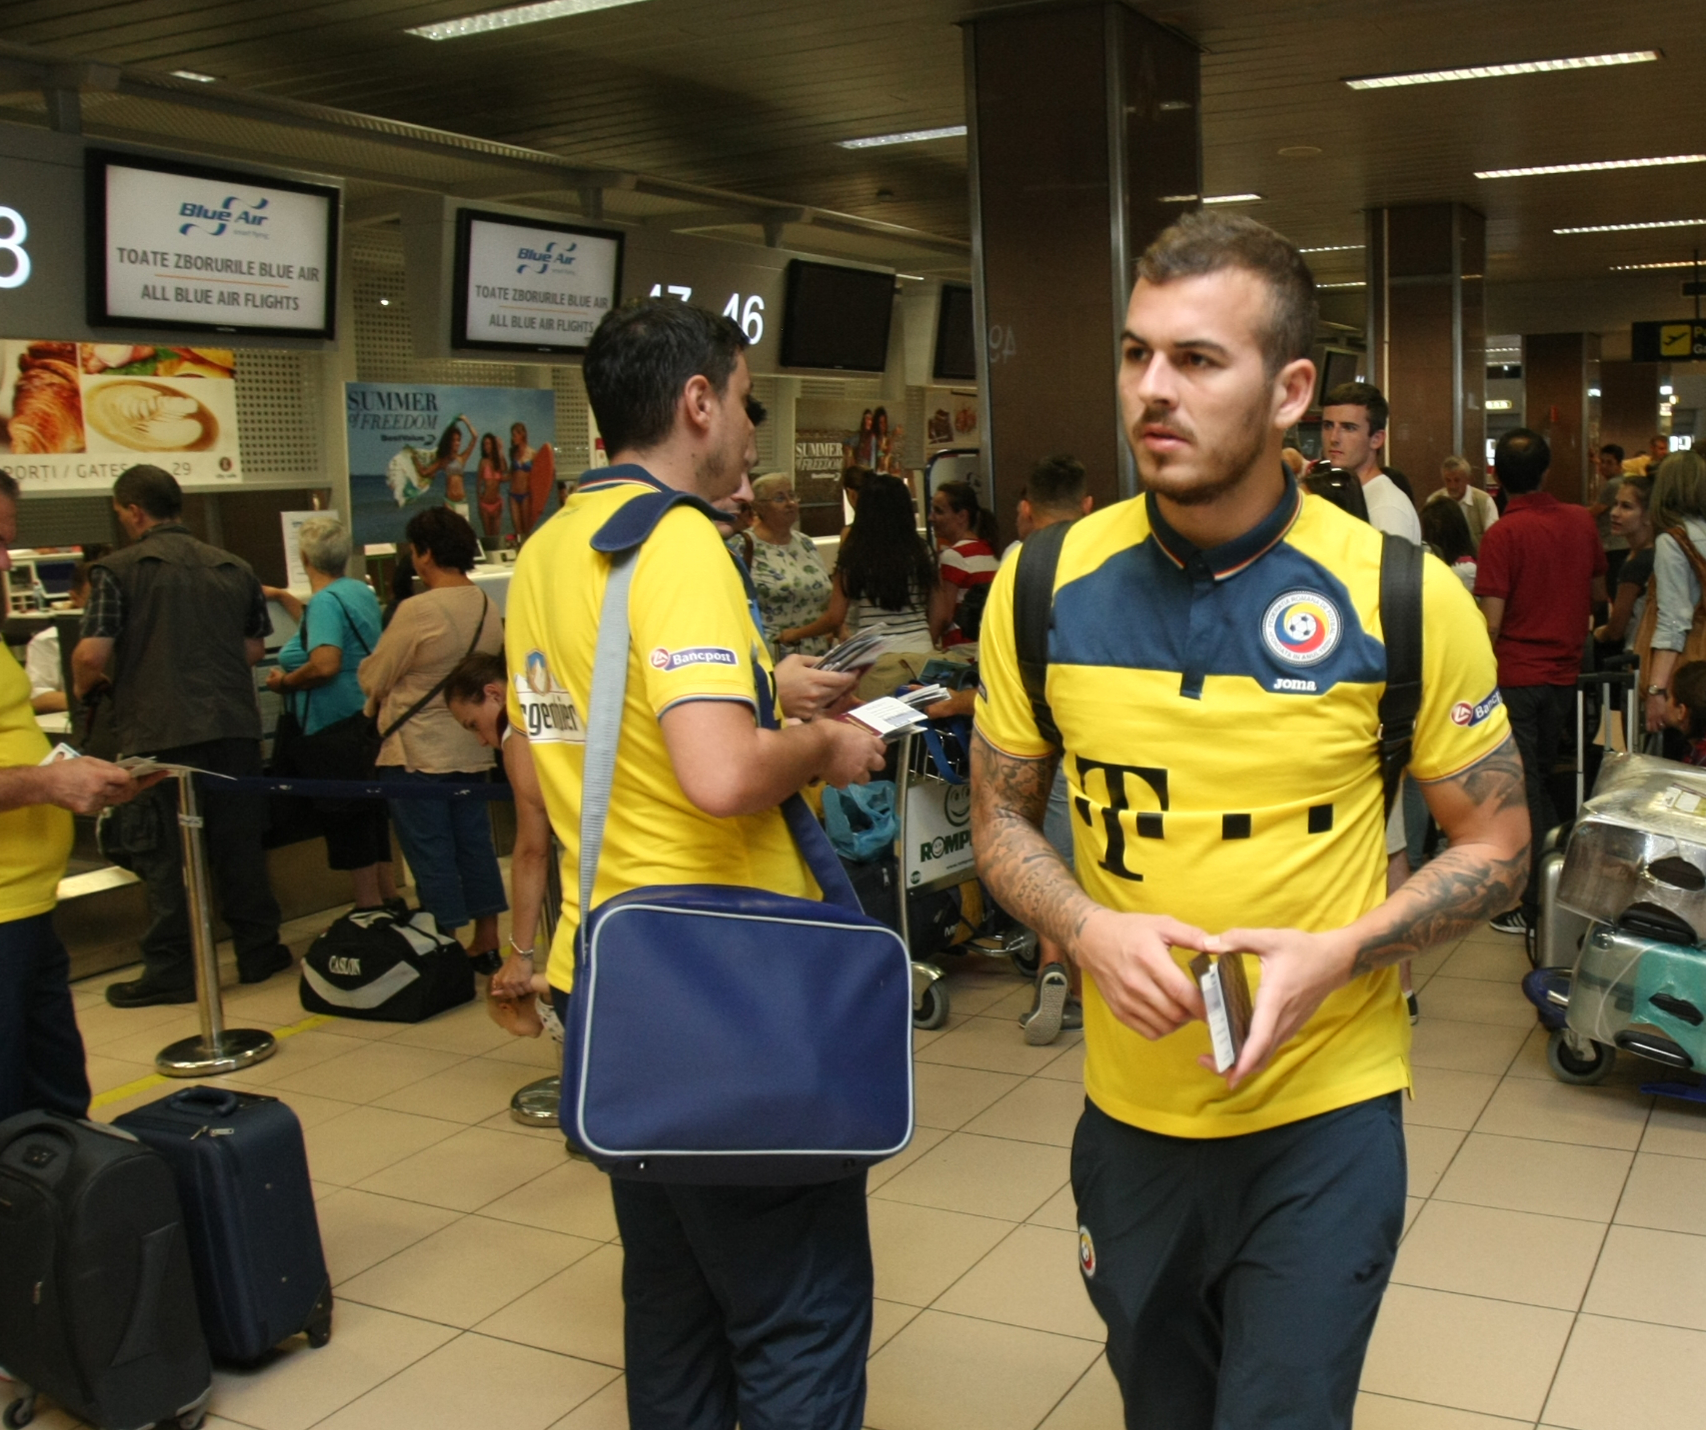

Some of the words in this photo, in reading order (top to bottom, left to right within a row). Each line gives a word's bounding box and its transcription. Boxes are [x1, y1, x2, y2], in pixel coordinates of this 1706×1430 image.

[179, 202, 232, 222] Blue
[234, 210, 268, 226] Air
[116, 247, 170, 268] TOATE
[174, 253, 255, 276] ZBORURILE
[258, 261, 294, 280] BLUE
[298, 265, 320, 282] AIR
[517, 248, 552, 262] Blue
[553, 253, 576, 265] Air
[141, 284, 170, 302] ALL
[174, 287, 212, 305] BLUE
[217, 289, 240, 307] AIR
[244, 293, 299, 311] FLIGHTS
[475, 285, 509, 301] TOATE
[512, 289, 565, 305] ZBORURILE
[568, 293, 590, 308] BLUE
[593, 296, 608, 309] AIR
[489, 314, 508, 328] ALL
[511, 315, 536, 330] BLUE
[539, 317, 555, 332] AIR
[557, 319, 594, 334] FLIGHTS
[347, 391, 438, 411] SUMMER
[360, 413, 438, 430] FREEDOM
[796, 442, 844, 457] SUMMER
[172, 462, 192, 476] 29
[672, 651, 732, 666] Bancpost
[920, 829, 972, 863] ROMP
